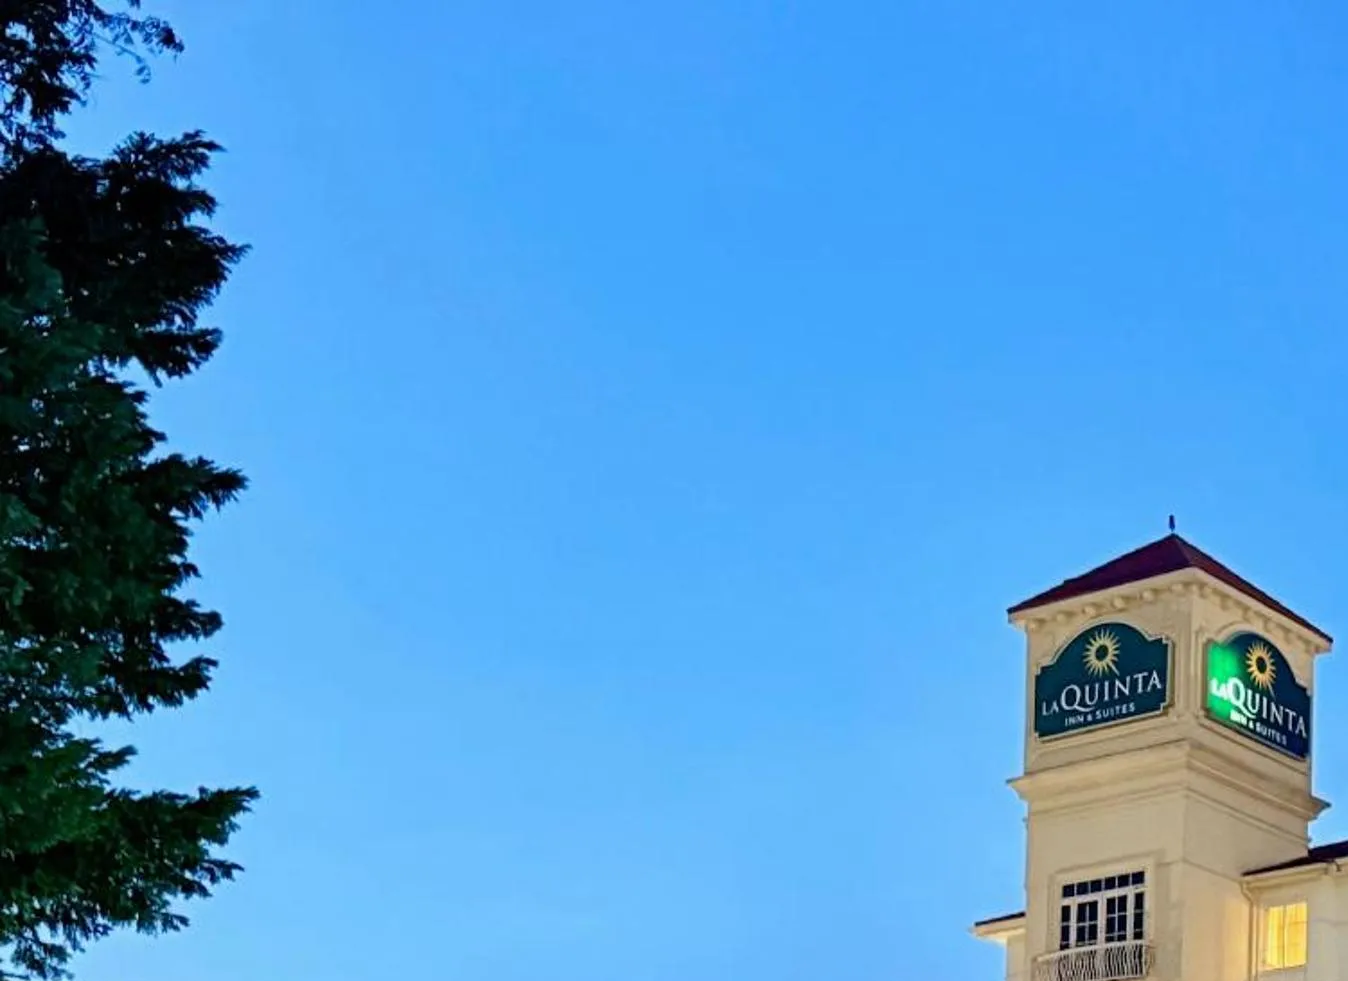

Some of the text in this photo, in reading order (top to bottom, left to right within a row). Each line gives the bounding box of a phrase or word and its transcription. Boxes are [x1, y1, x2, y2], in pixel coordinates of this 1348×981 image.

[1060, 669, 1162, 712] QUINTA
[1227, 677, 1307, 738] QUINTA
[1064, 714, 1084, 727] INN
[1095, 702, 1136, 720] SUITES
